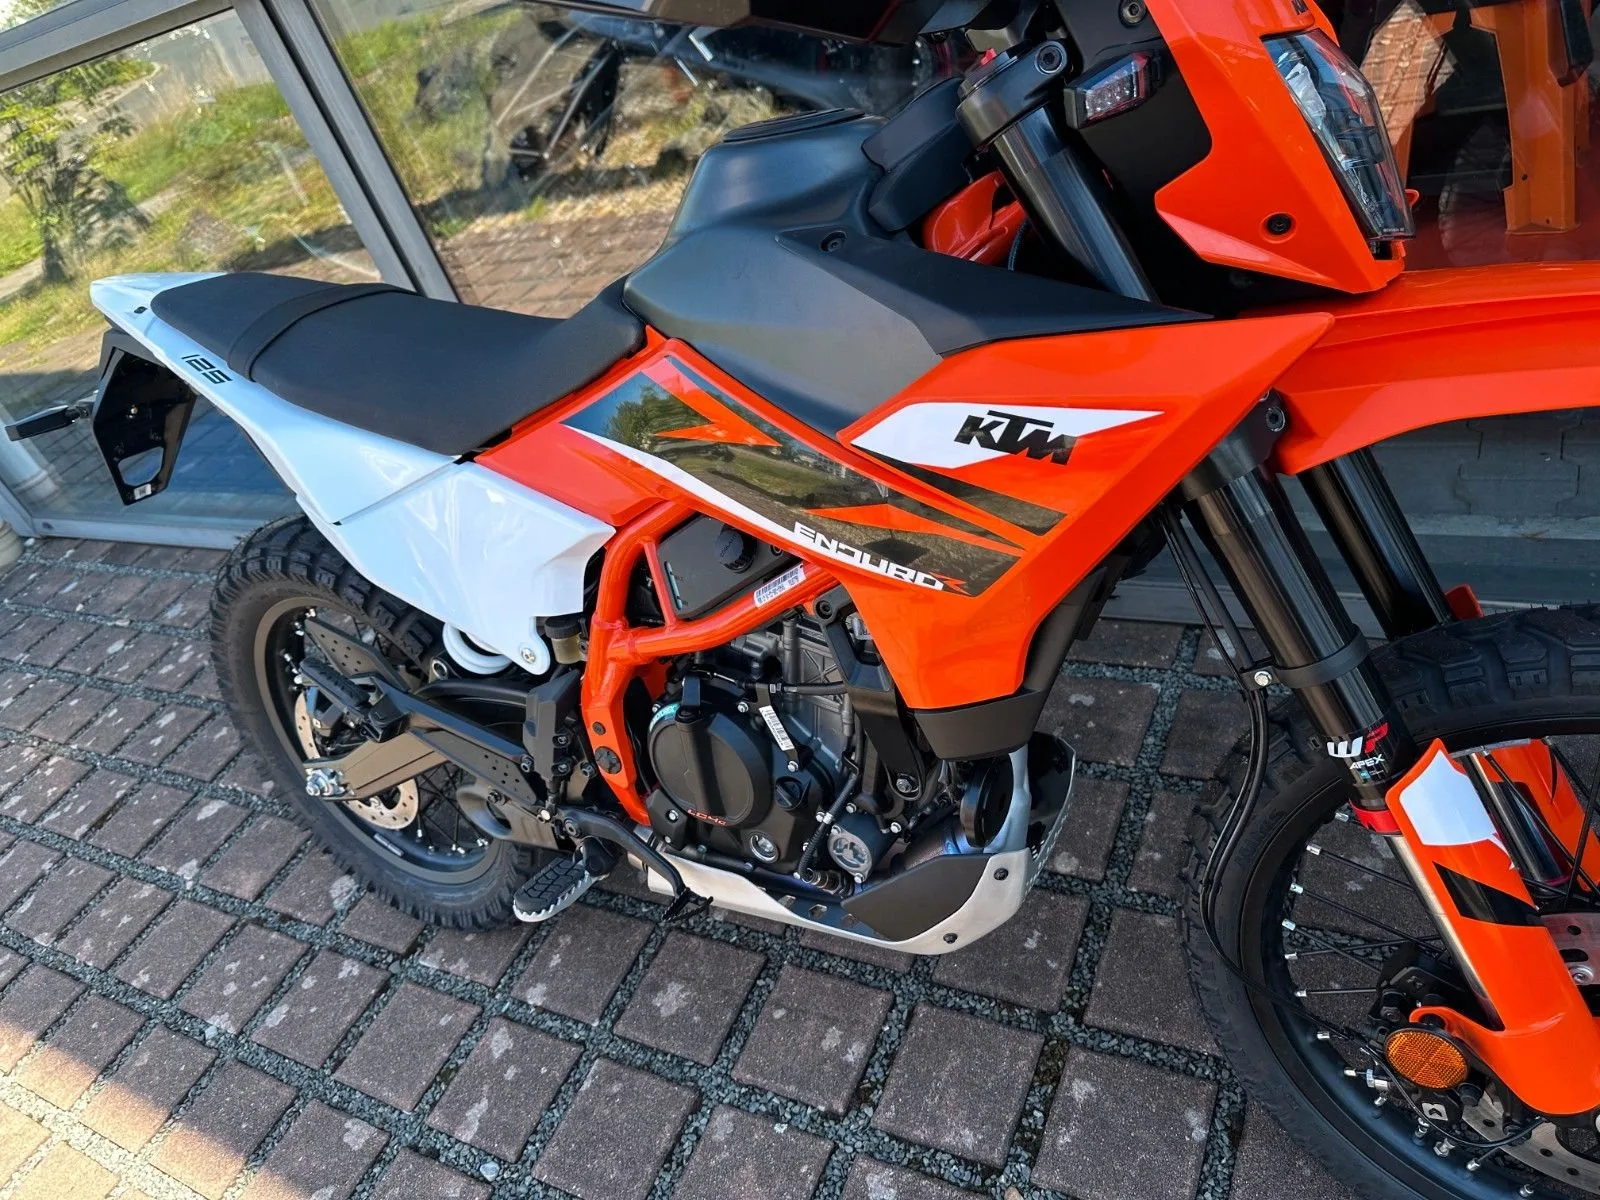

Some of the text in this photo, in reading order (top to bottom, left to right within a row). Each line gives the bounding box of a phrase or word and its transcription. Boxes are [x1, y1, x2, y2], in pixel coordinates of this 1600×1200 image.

[181, 354, 233, 384] 125
[954, 410, 1077, 465] KTM
[793, 521, 944, 591] ENDURO
[1350, 753, 1385, 770] APEX
